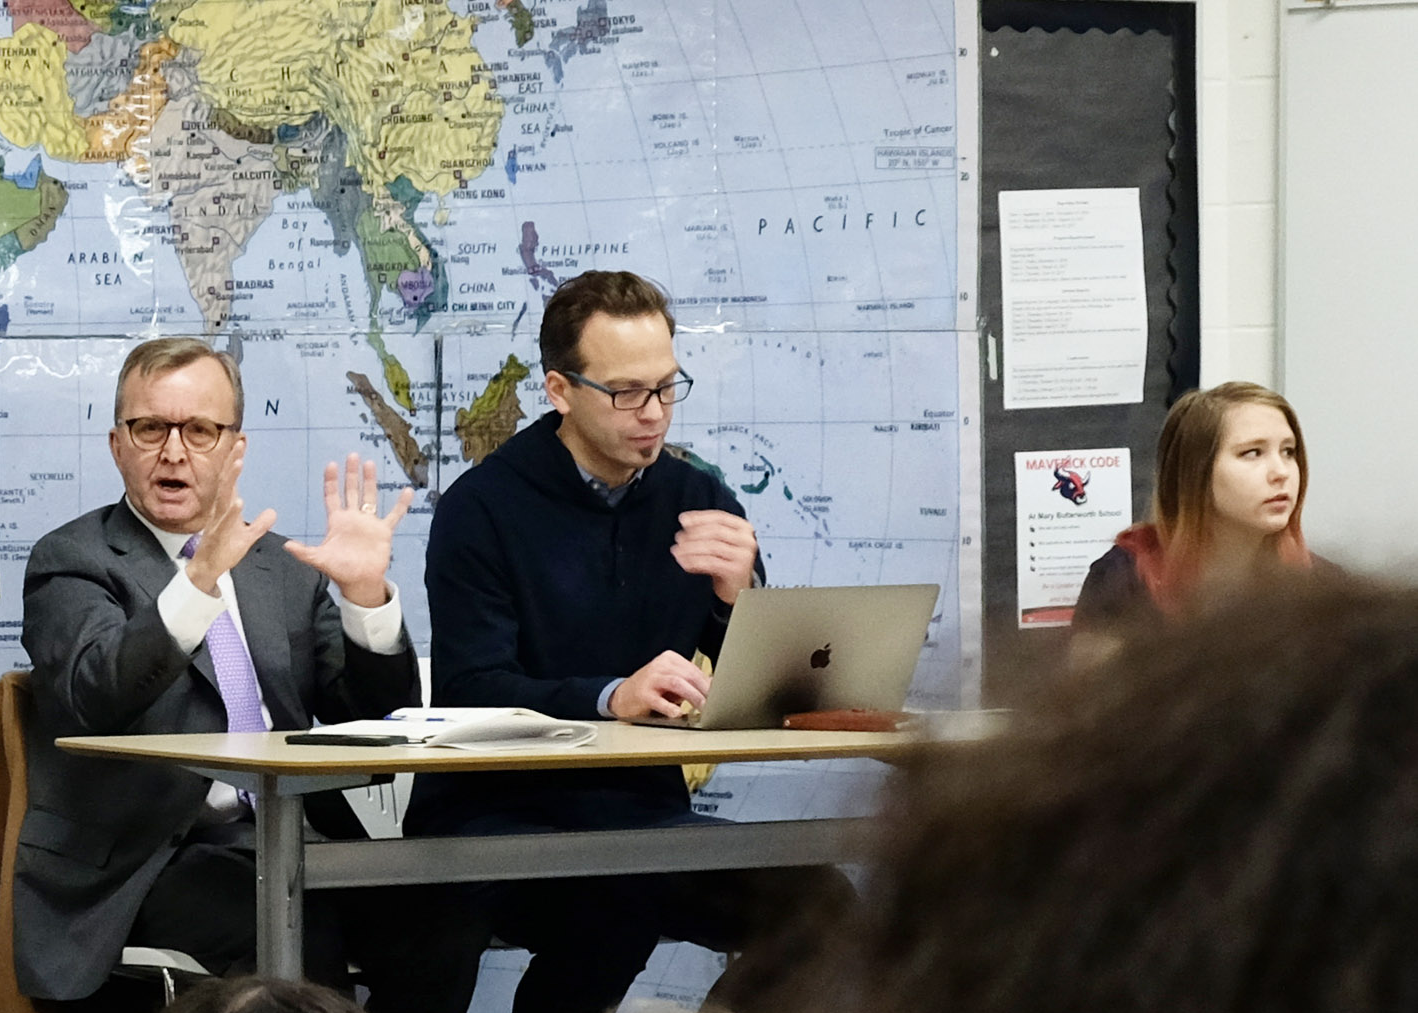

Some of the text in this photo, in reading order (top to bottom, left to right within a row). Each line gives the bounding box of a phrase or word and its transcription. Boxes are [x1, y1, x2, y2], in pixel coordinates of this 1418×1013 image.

[1, 47, 36, 57] TEHRAN
[959, 48, 967, 56] 30
[497, 73, 541, 84] SHANGHAI
[518, 82, 544, 93] EAST
[514, 102, 549, 114] CHINA
[521, 124, 541, 134] SEA
[884, 128, 911, 137] Tropic
[924, 124, 953, 134] Cancer
[440, 158, 495, 169] GUANGZHOU
[232, 170, 278, 181] CALCUTTA
[961, 172, 969, 181] 20
[453, 190, 505, 200] HONG KONG
[184, 204, 259, 217] INDIA
[30, 205, 56, 237] OMAN
[282, 218, 307, 232] Bay
[758, 210, 927, 235] PACIFIC
[289, 238, 302, 250] of
[458, 243, 497, 254] SOUTH
[541, 243, 629, 256] PHILIPPINE
[268, 258, 321, 272] Bengal
[94, 272, 123, 287] SEA
[236, 279, 274, 289] MADRAS
[459, 282, 496, 293] CHINA
[497, 301, 515, 310] CITY
[924, 409, 954, 418] Equator
[1090, 456, 1120, 468] CODE
